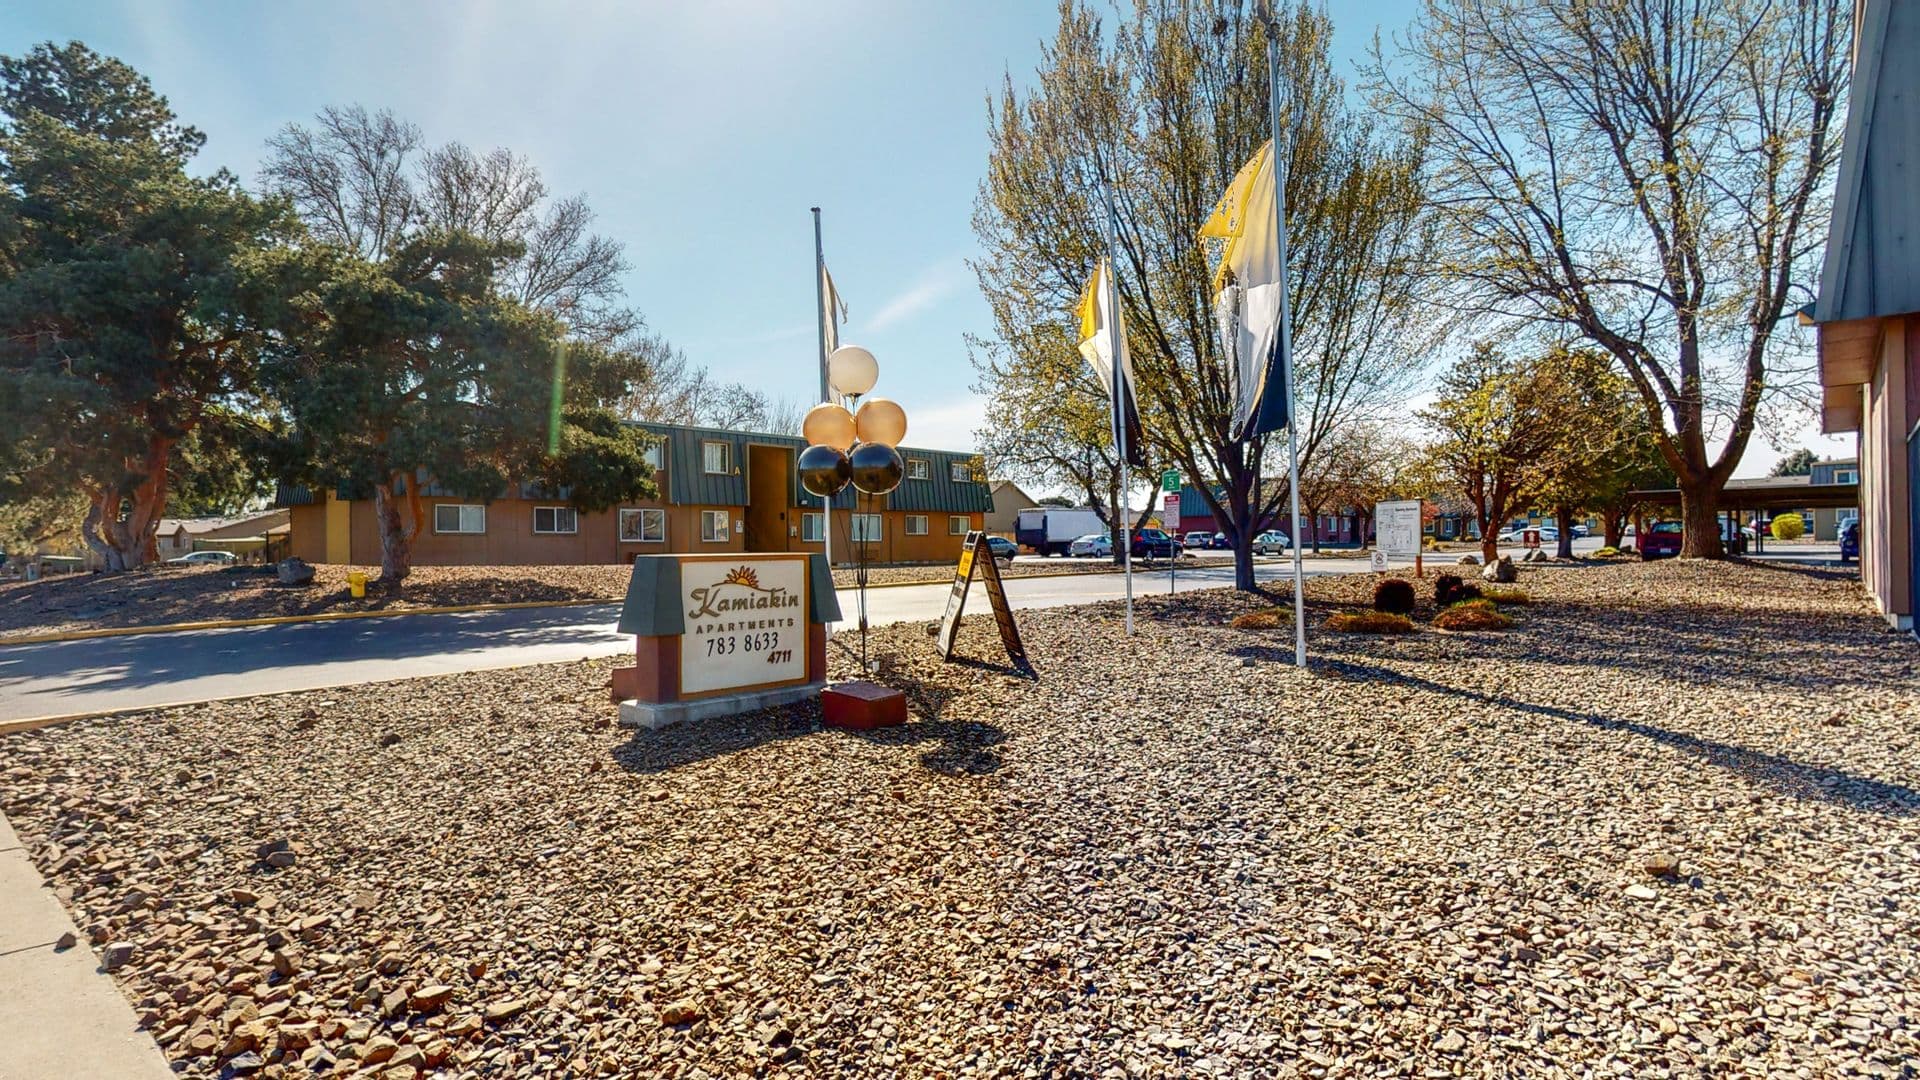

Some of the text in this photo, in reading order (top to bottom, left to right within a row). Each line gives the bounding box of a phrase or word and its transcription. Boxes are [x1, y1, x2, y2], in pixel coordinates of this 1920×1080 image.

[1168, 477, 1174, 486] 5
[688, 587, 799, 619] Kamiakin
[696, 618, 795, 634] APARTMENTS
[707, 632, 778, 657] 783 8633
[767, 650, 792, 664] 4711
